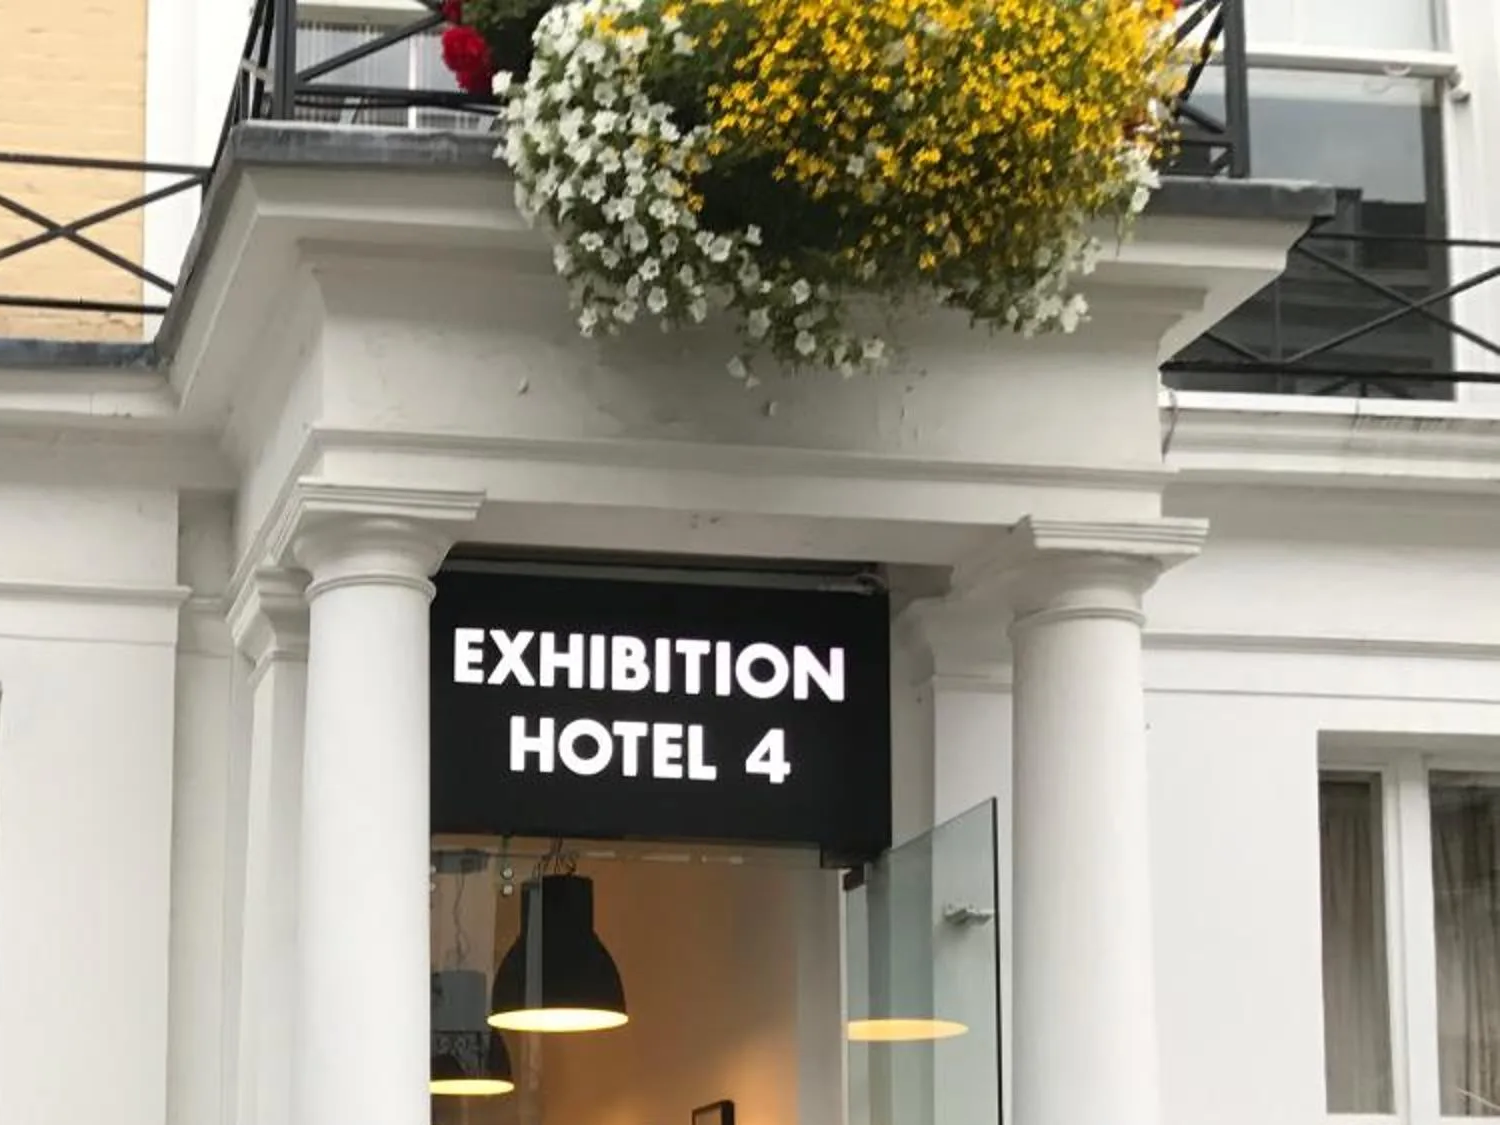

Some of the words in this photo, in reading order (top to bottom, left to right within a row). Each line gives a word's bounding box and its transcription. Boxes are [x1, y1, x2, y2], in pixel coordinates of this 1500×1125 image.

[453, 627, 845, 702] EXHIBITION
[509, 715, 717, 781] HOTEL
[745, 728, 791, 784] 4
